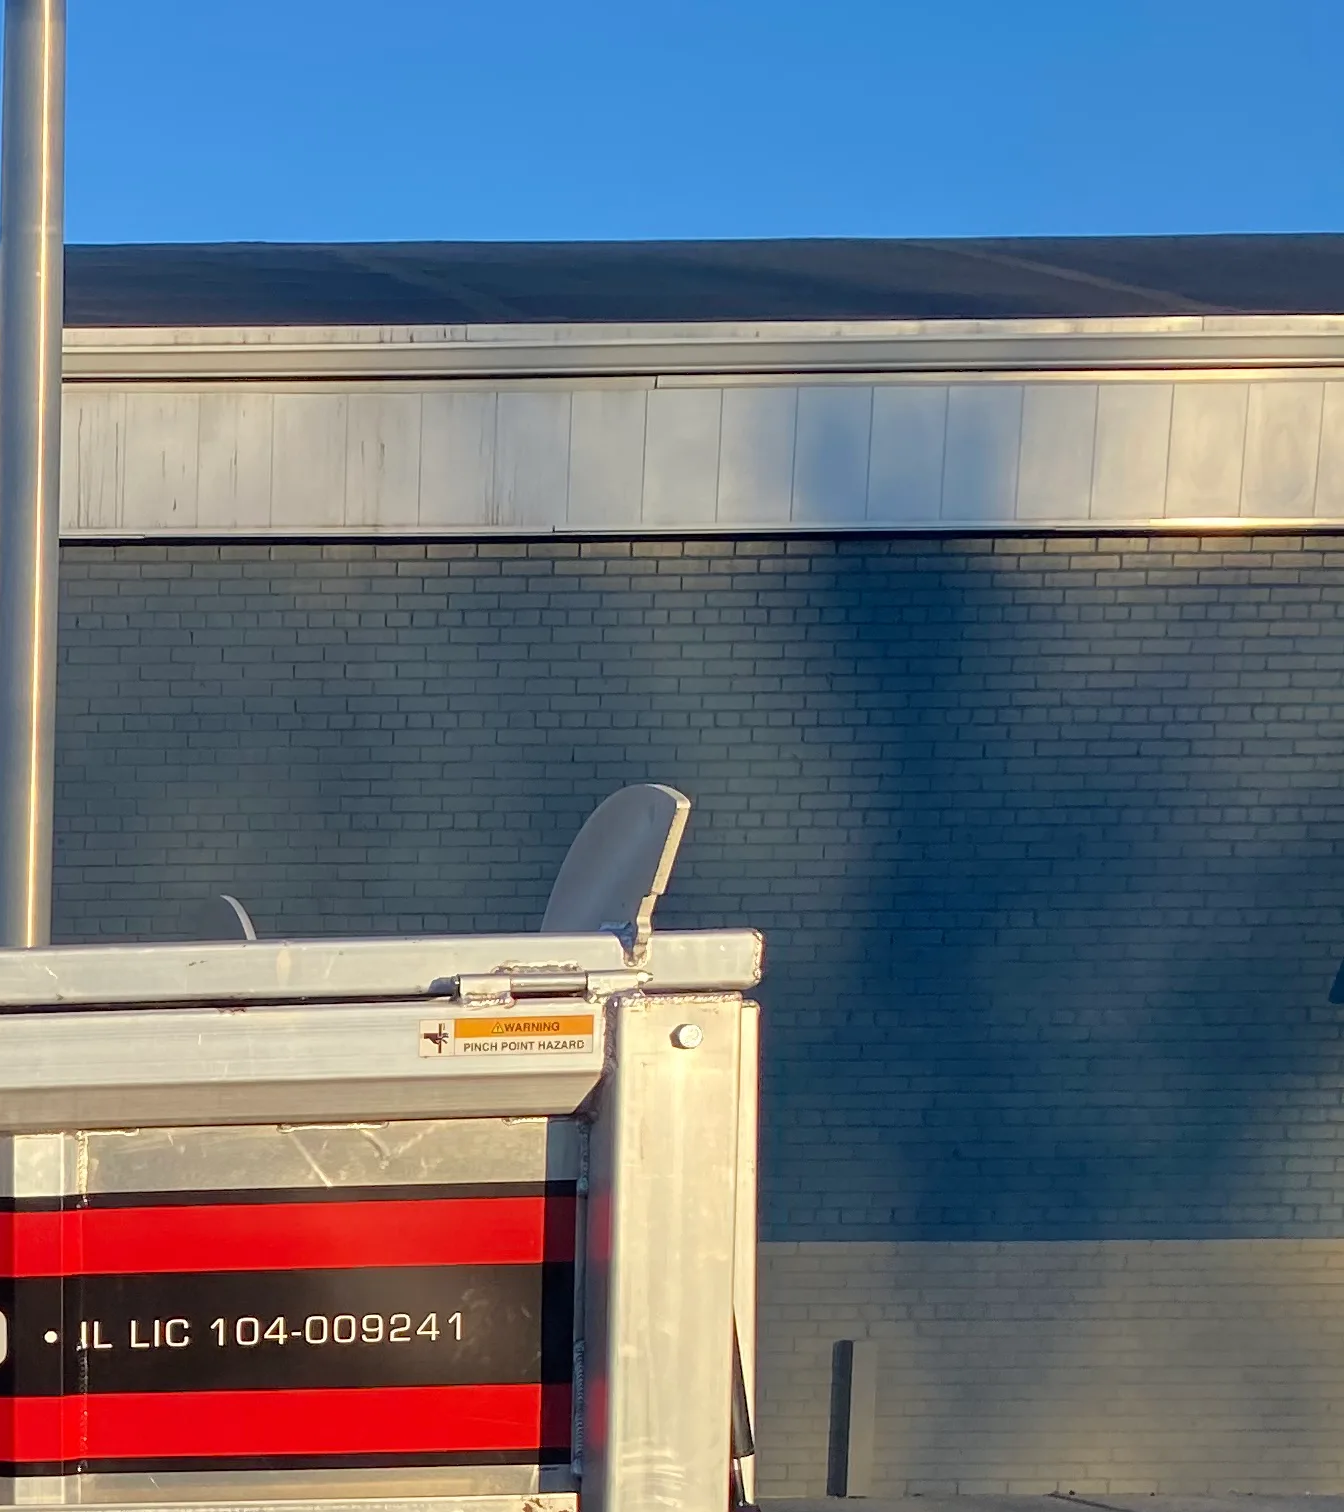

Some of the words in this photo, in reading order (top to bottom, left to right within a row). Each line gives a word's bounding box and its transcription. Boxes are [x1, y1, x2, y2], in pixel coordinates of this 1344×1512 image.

[504, 1022, 560, 1032] WARNING
[463, 1042, 498, 1052] PINCH
[501, 1041, 535, 1051] POINT
[538, 1040, 585, 1050] HAZARD
[80, 1320, 112, 1349] IL
[130, 1318, 191, 1349] LIC
[210, 1311, 465, 1347] 104-009241
